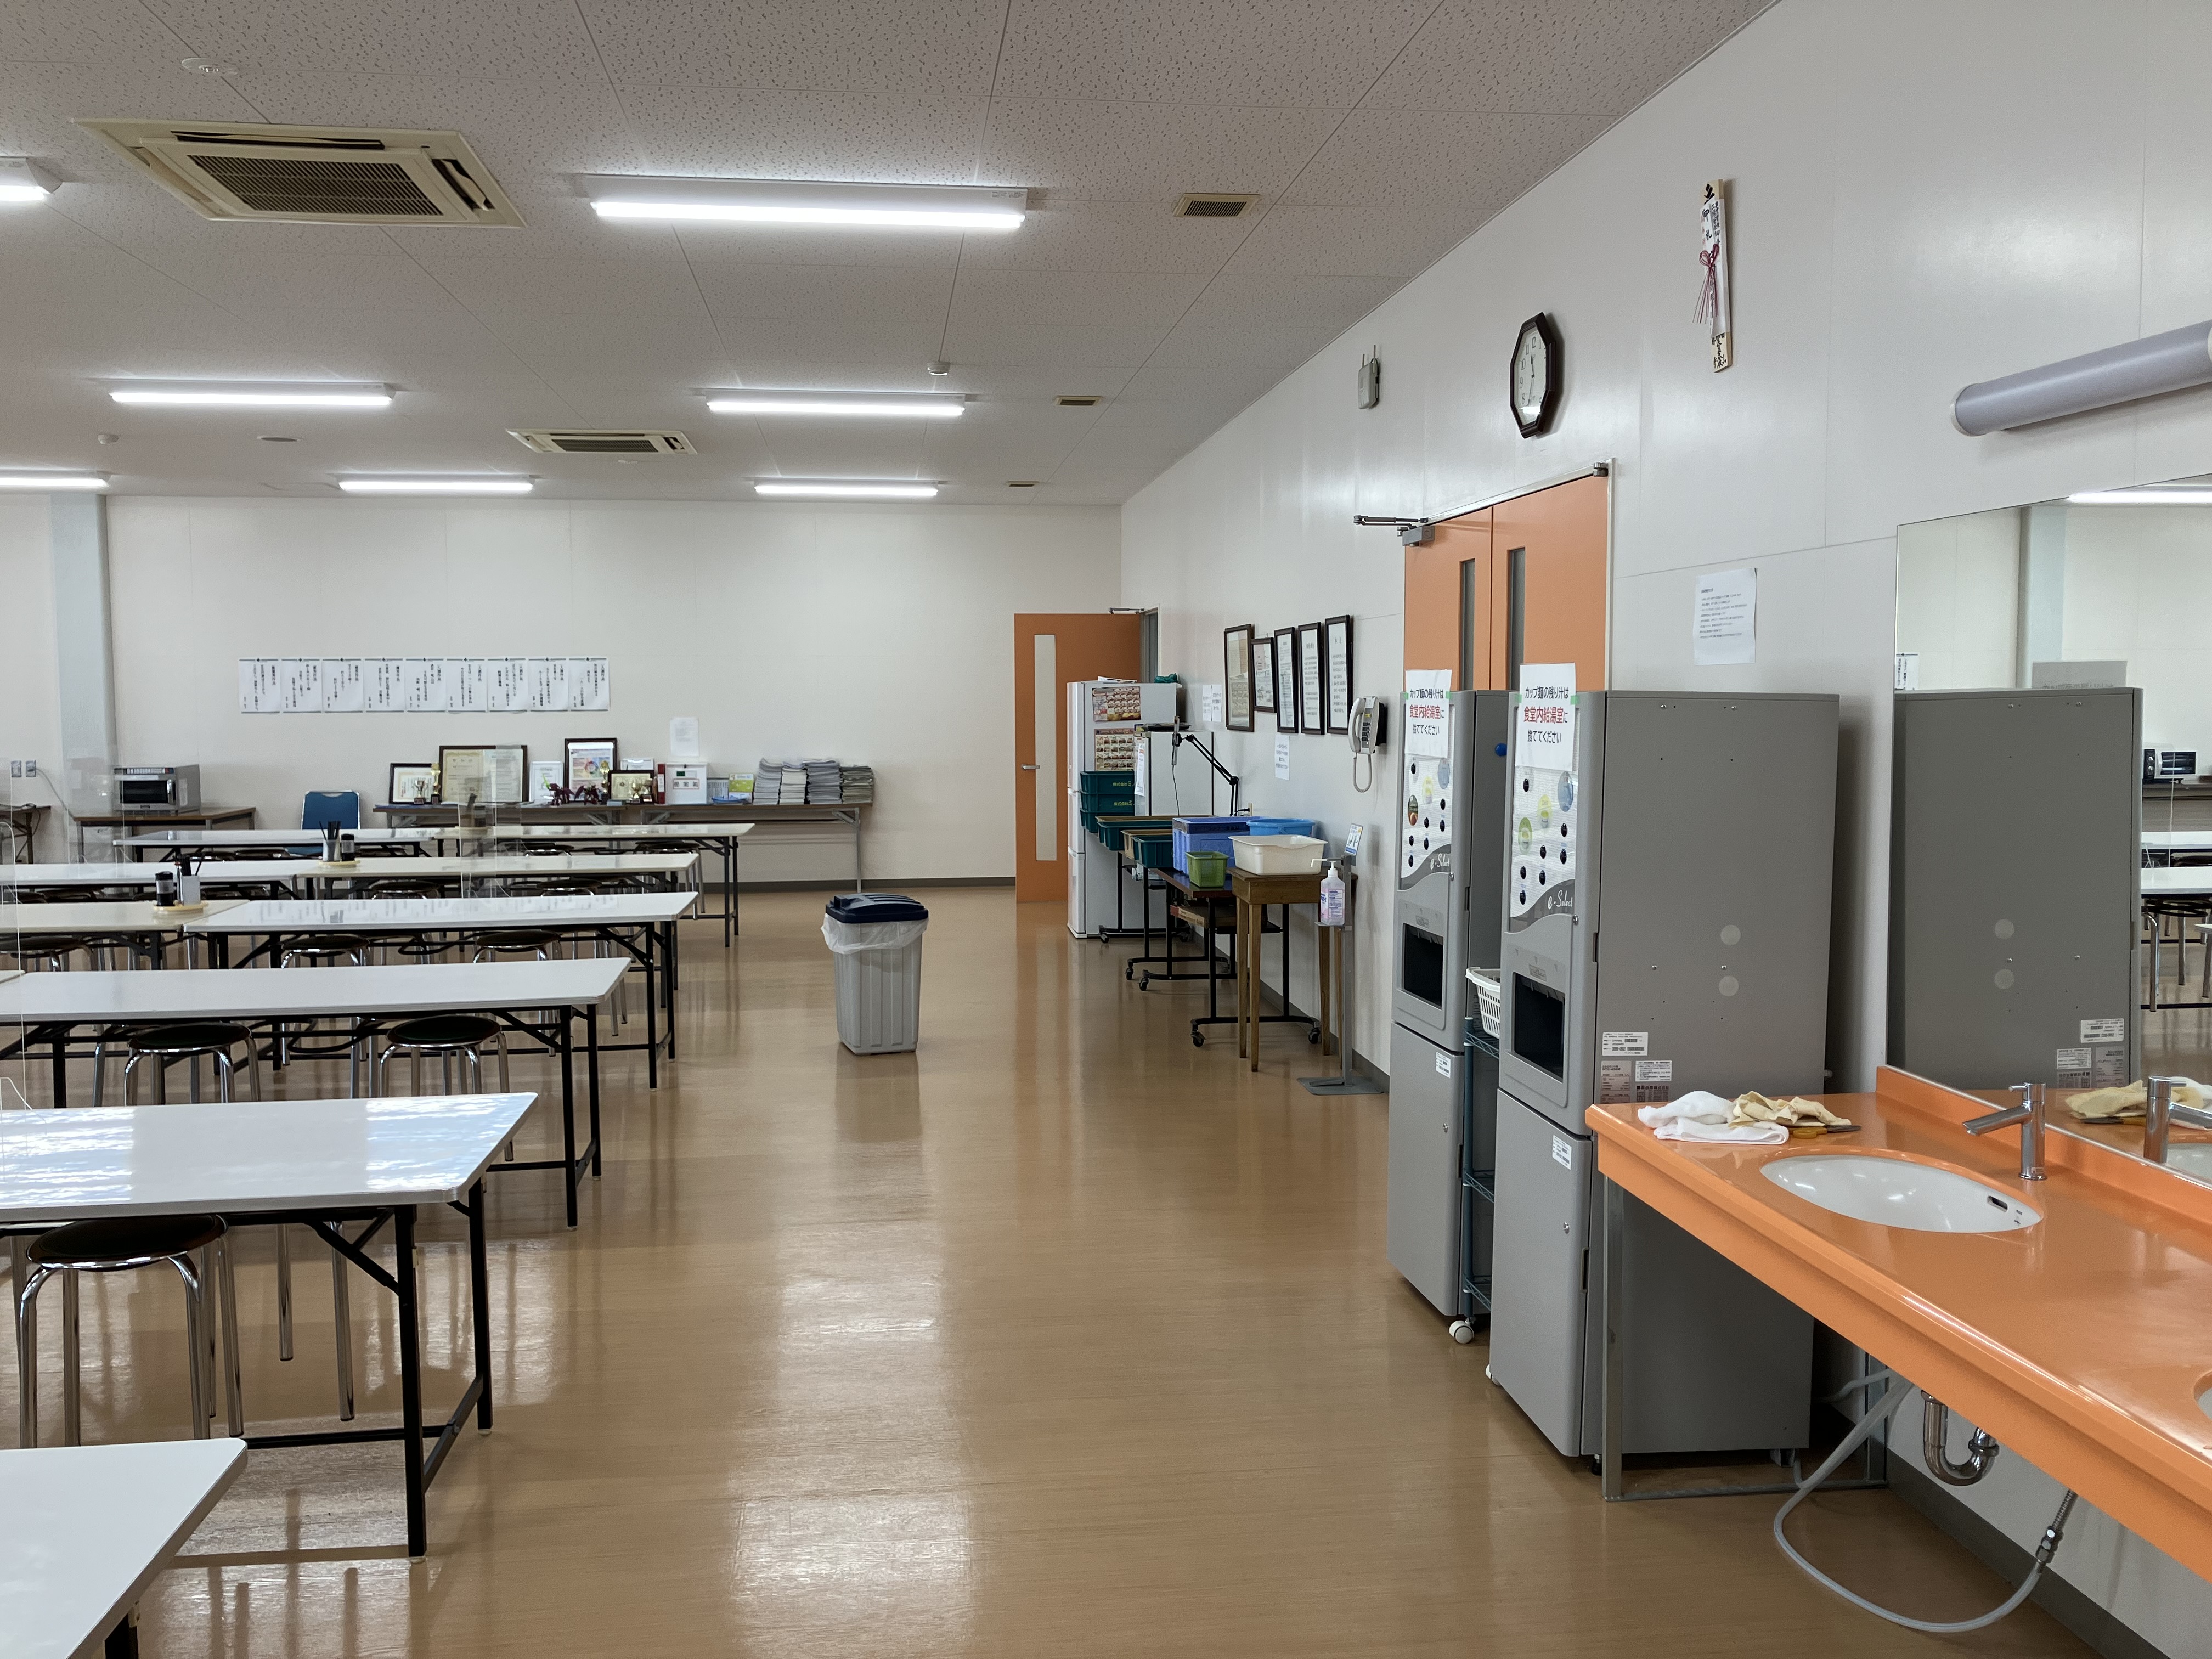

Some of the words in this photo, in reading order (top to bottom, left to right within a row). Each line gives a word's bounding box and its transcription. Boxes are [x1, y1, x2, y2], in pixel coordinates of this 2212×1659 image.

[1410, 688, 1444, 699] カップ麺の残り汁は
[1525, 686, 1569, 699] カップ麺の残り汁は
[1409, 704, 1444, 719] 食堂内給湯室に
[1523, 706, 1568, 724] 食堂内給湯室に
[1413, 723, 1440, 735] 捨ててください
[1527, 729, 1562, 743] 捨ててください
[1430, 853, 1450, 870] e-Select
[1548, 890, 1573, 910] e-Select
